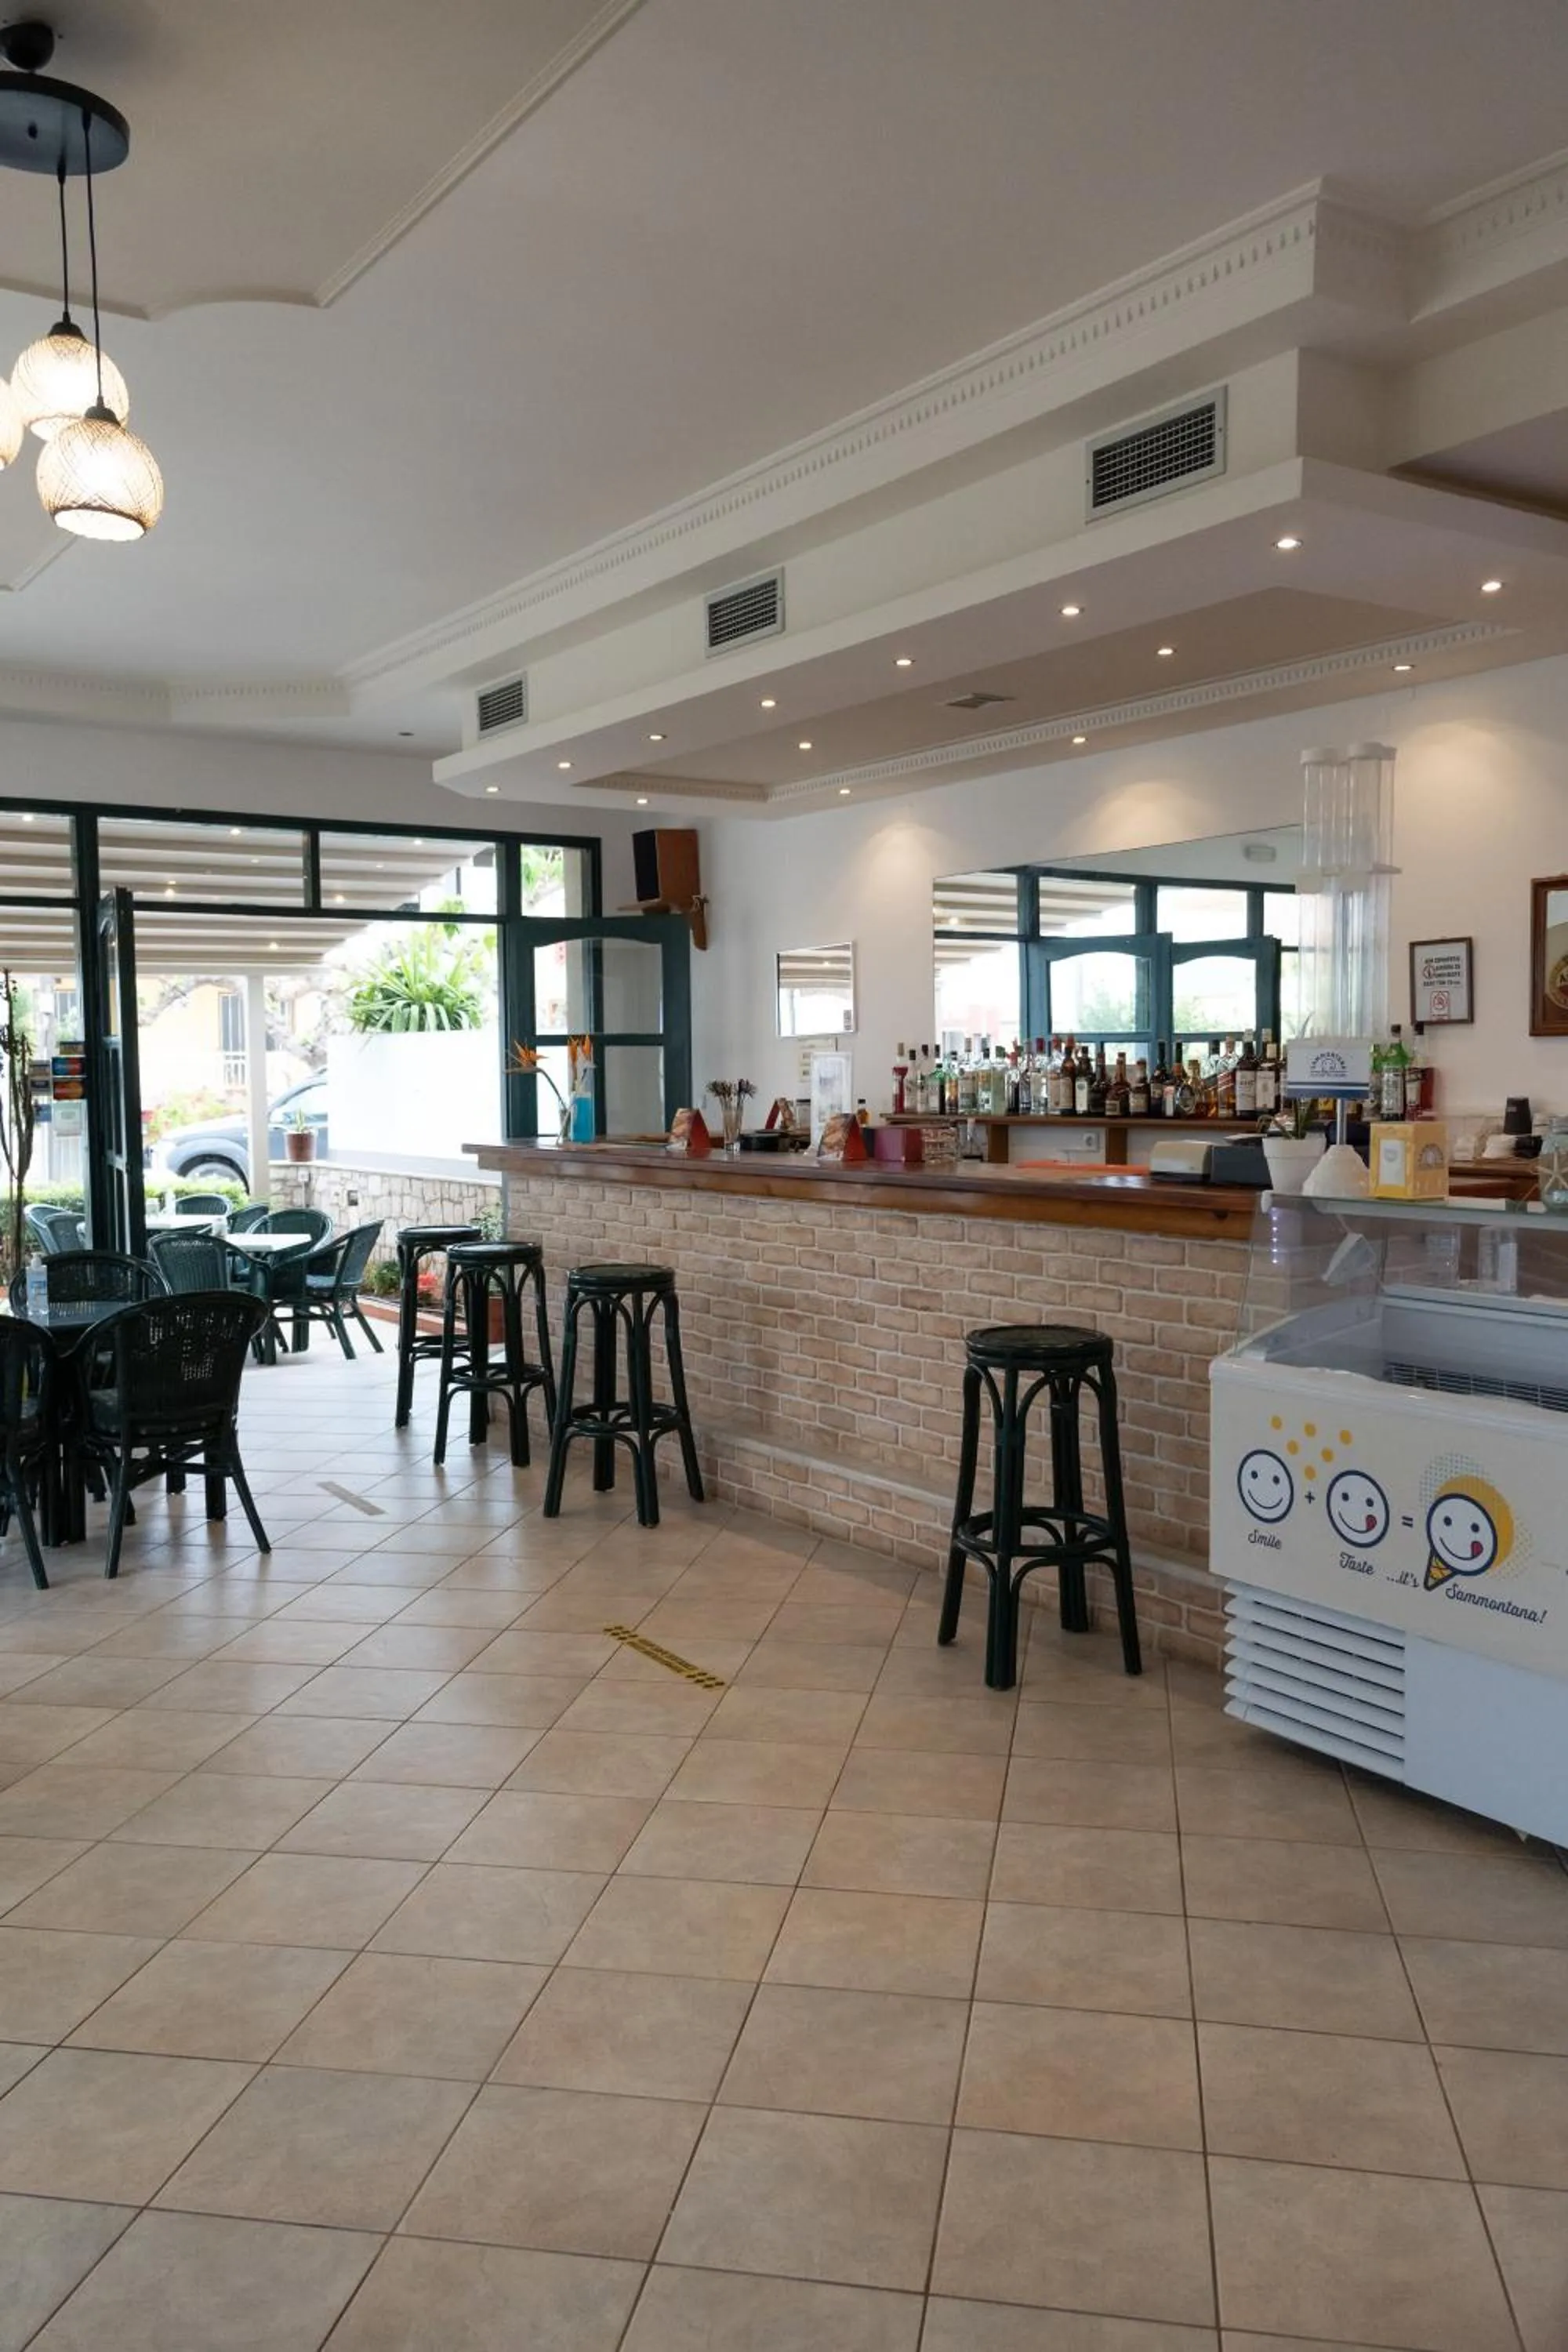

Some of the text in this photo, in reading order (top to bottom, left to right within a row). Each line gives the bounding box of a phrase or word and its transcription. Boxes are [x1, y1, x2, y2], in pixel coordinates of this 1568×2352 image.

[1247, 1529, 1282, 1550] Smile
[1339, 1552, 1374, 1575] Taste
[1445, 1583, 1548, 1624] Sammontana!
